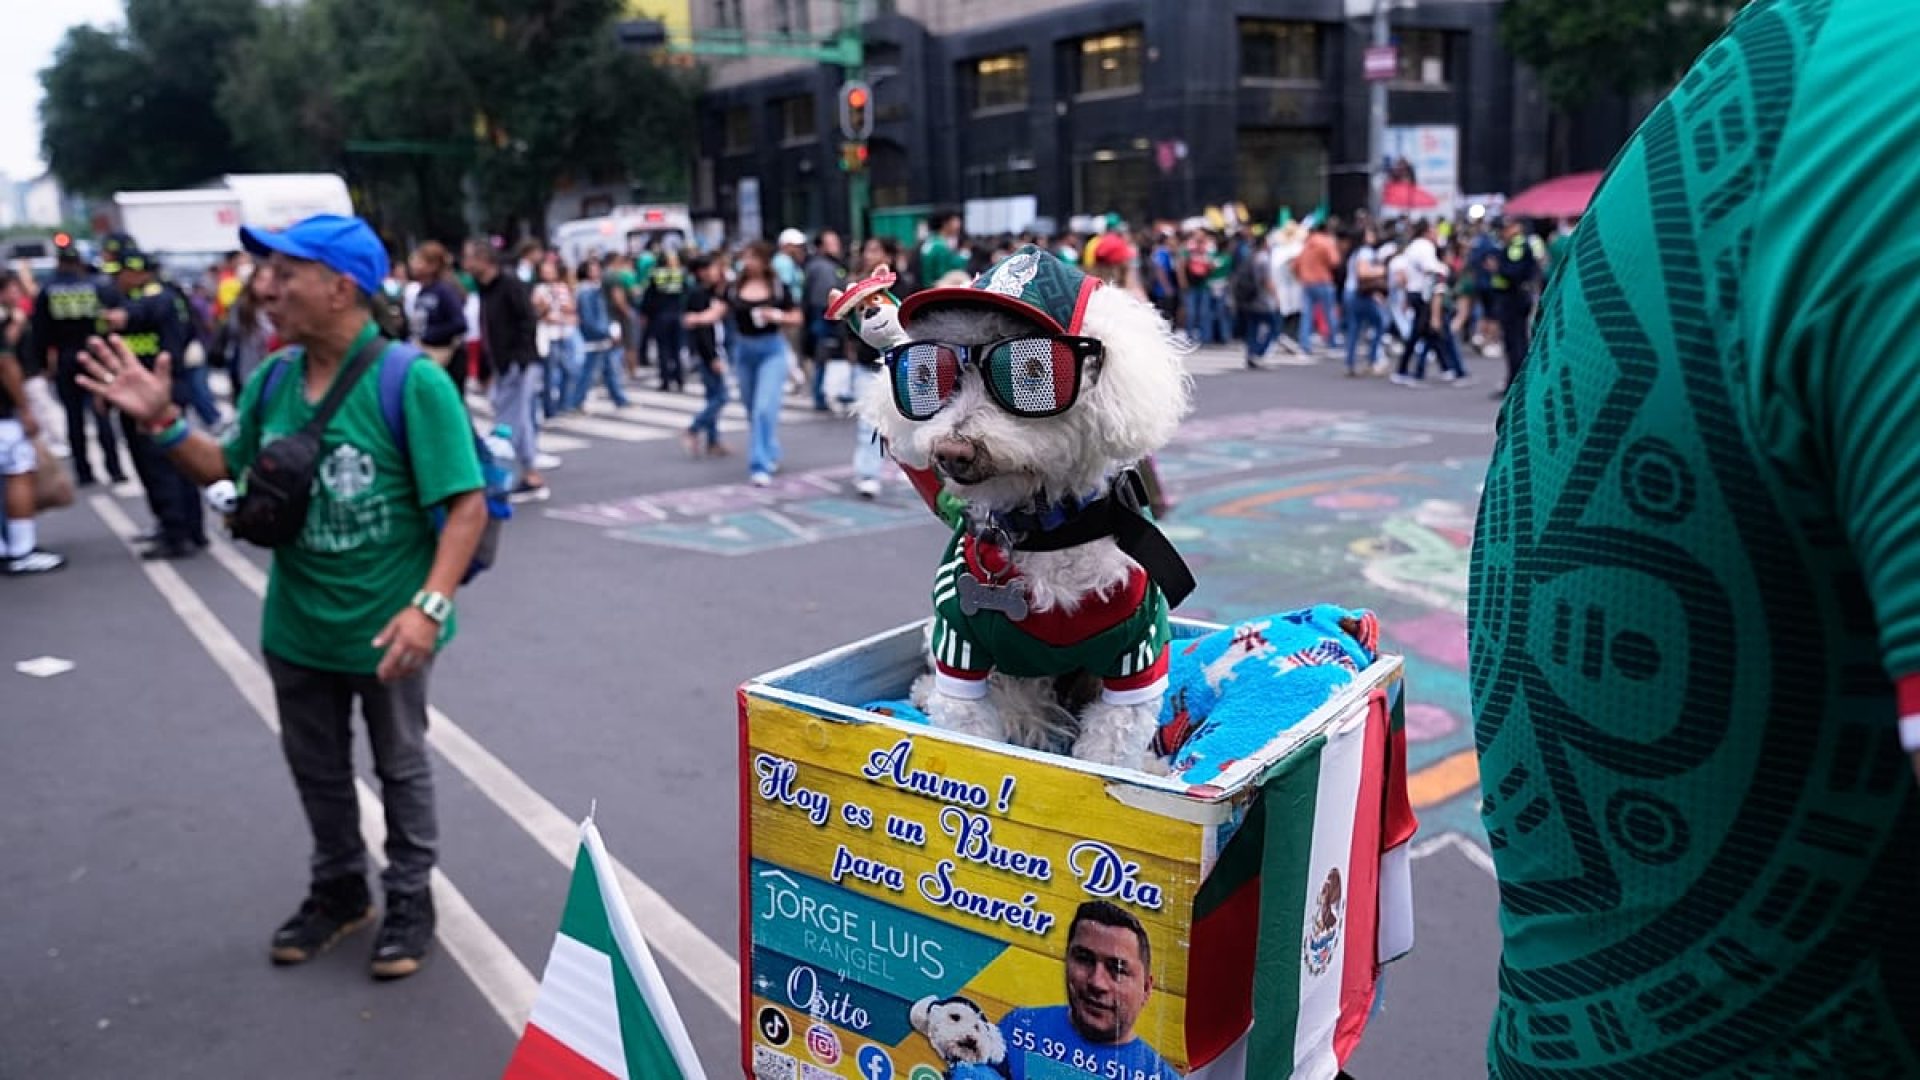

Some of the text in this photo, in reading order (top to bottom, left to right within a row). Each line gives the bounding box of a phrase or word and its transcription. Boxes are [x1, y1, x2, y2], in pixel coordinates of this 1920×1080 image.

[999, 776, 1015, 811] !
[755, 755, 1161, 907] Hoy es un Buen Día
[832, 844, 1054, 934] para Sonreír
[762, 883, 945, 979] JORGE LUIS
[804, 930, 895, 980] RANGEL
[787, 966, 871, 1029] Osito
[1012, 1028, 1036, 1050] 55
[1042, 1038, 1066, 1060] 39
[1073, 1049, 1097, 1072] 86
[1105, 1060, 1126, 1080] 51
